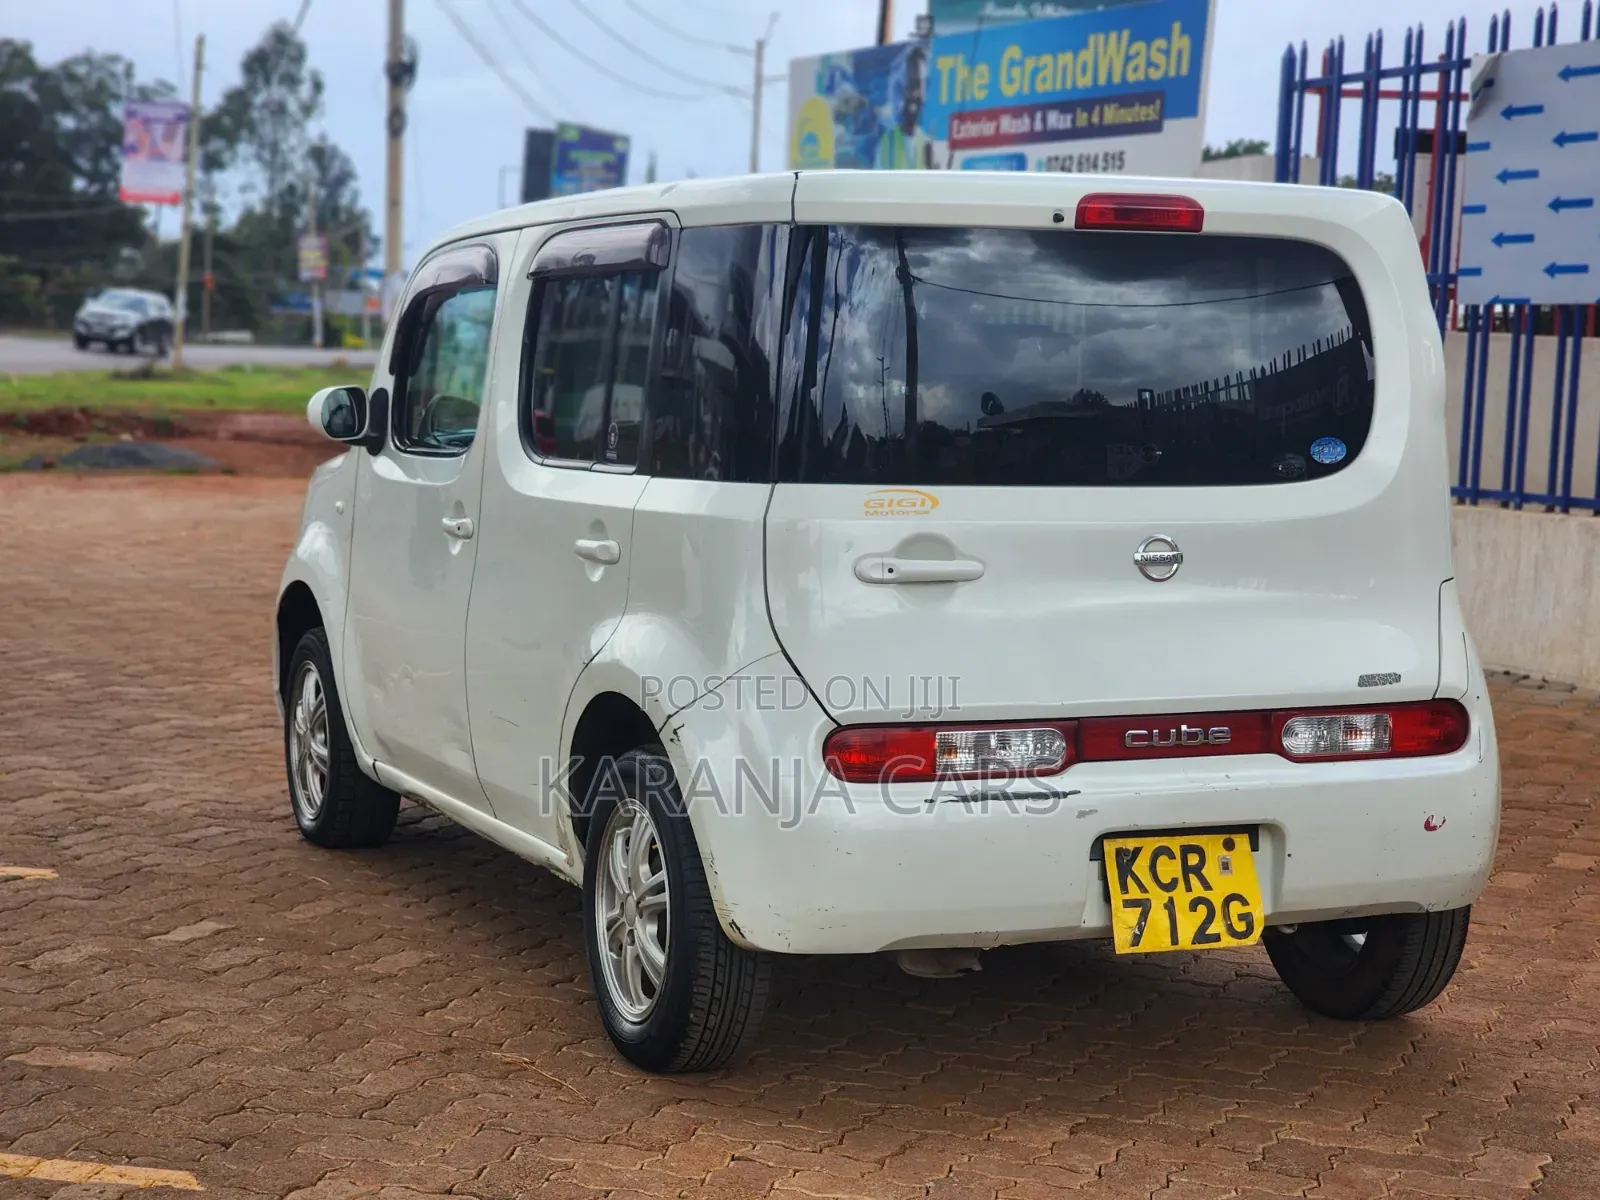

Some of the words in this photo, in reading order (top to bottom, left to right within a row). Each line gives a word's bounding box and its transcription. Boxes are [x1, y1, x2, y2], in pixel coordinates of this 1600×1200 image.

[936, 55, 989, 105] The
[999, 22, 1191, 97] GrandWash
[952, 117, 998, 140] Exterior
[1000, 113, 1031, 134] Wash
[1033, 110, 1043, 131] &
[1046, 108, 1073, 130] Wax
[1091, 105, 1100, 126] 4
[1103, 98, 1160, 125] Minutes!
[1076, 153, 1101, 173] 614
[1103, 150, 1126, 172] 515
[864, 498, 926, 508] GIGI
[1140, 554, 1178, 562] NISSAN
[1125, 724, 1231, 748] cube
[1115, 843, 1214, 895] KCR
[1122, 893, 1254, 947] 712G
